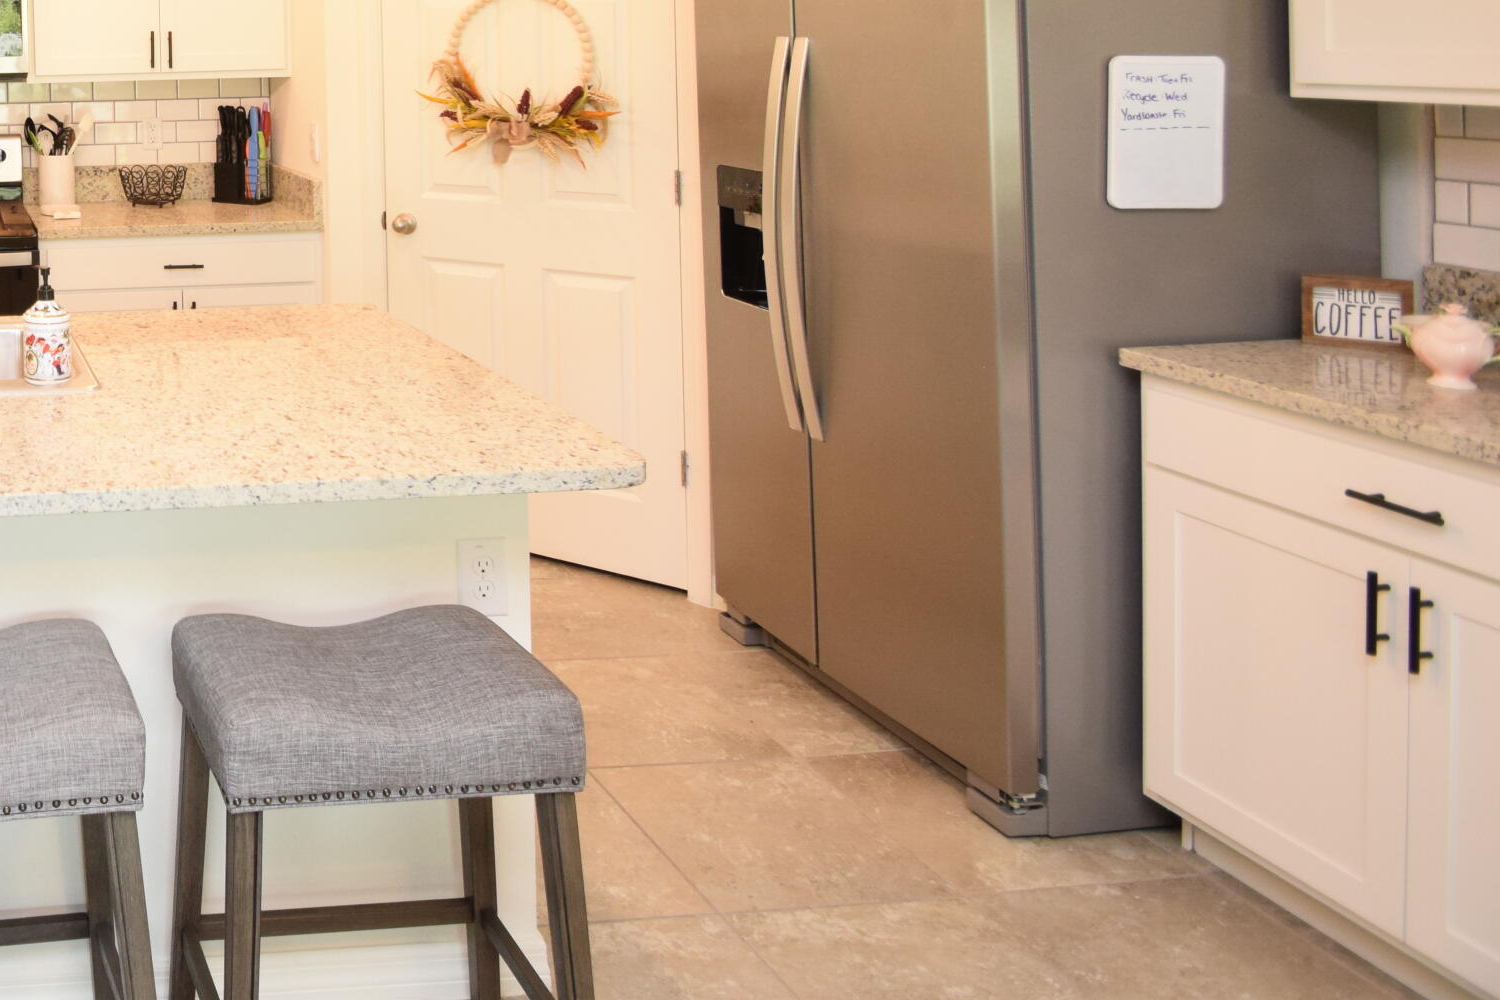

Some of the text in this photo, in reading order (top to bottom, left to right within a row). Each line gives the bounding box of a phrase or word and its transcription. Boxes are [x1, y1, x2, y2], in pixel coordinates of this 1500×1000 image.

[1164, 91, 1188, 101] Wed
[1173, 109, 1186, 118] Fri
[1337, 288, 1376, 305] HELLO
[1314, 301, 1401, 341] COFFEE
